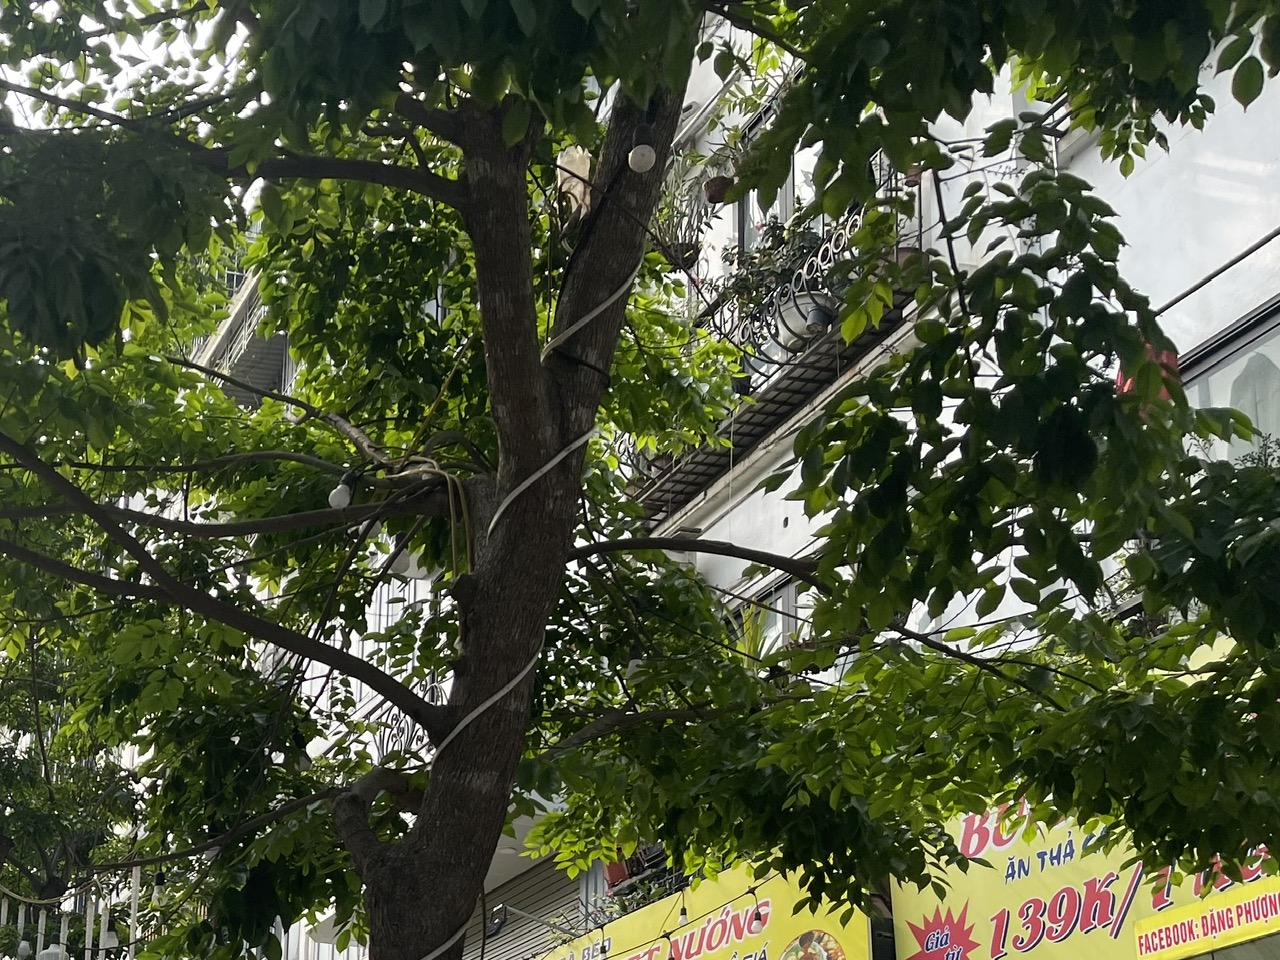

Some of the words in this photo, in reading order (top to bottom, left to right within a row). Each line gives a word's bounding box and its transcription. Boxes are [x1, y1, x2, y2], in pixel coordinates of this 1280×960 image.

[1005, 854, 1030, 884] ĂN
[1037, 831, 1075, 872] THẢ
[1138, 919, 1199, 956] FACEBOOK:
[1201, 908, 1234, 939] ĐẶNG
[1236, 892, 1280, 926] PHƯỢN
